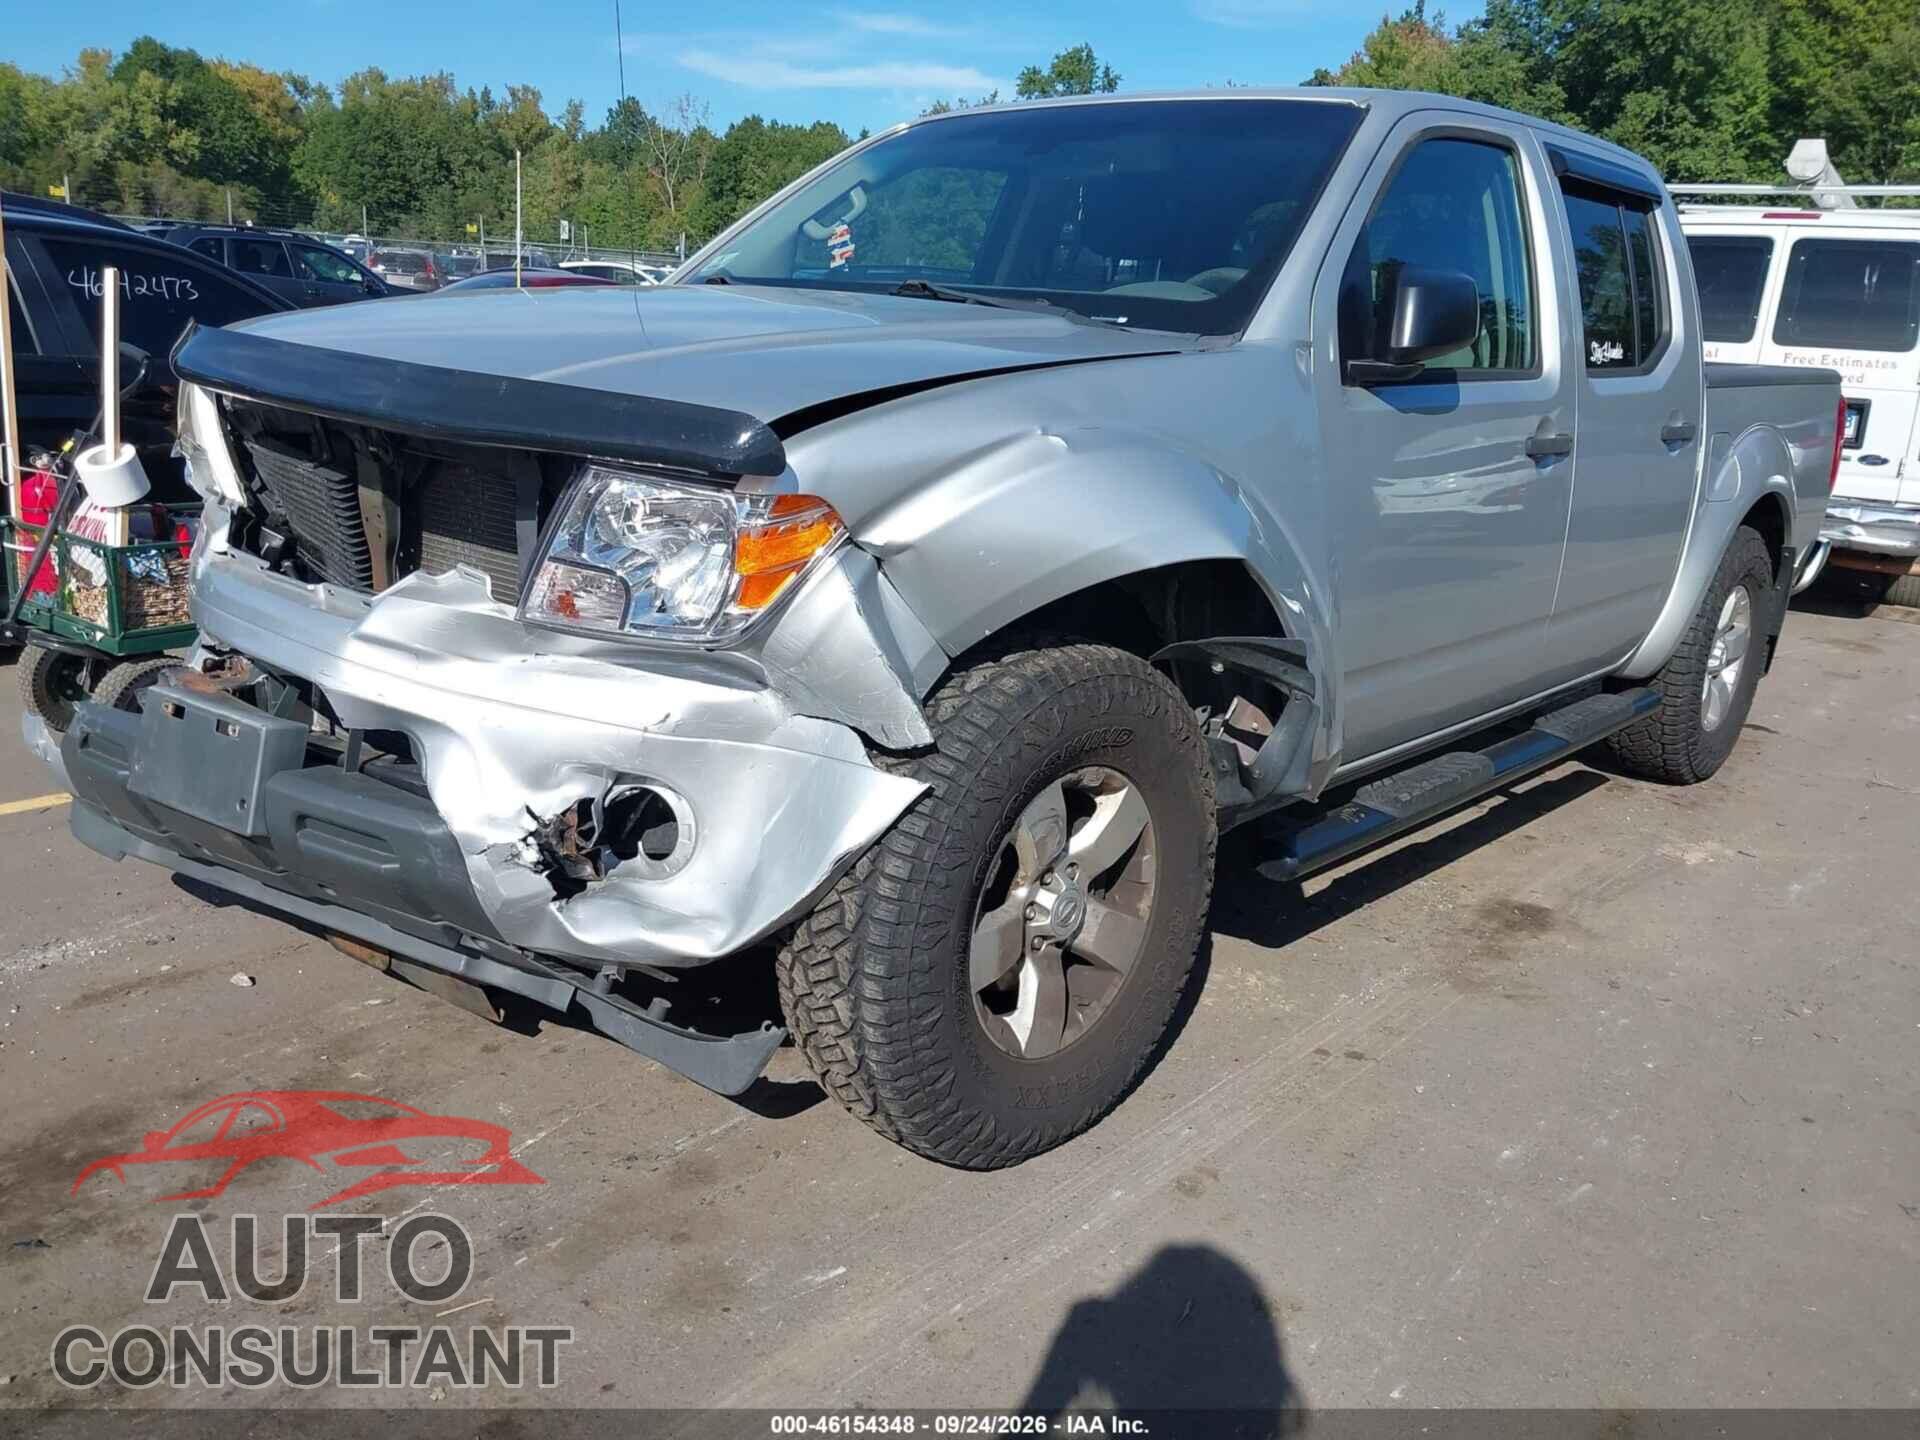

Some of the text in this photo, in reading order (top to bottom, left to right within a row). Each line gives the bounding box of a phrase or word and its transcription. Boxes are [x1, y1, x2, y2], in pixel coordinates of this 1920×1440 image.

[67, 265, 199, 301] 4642473
[1783, 352, 1898, 370] Free Estimates
